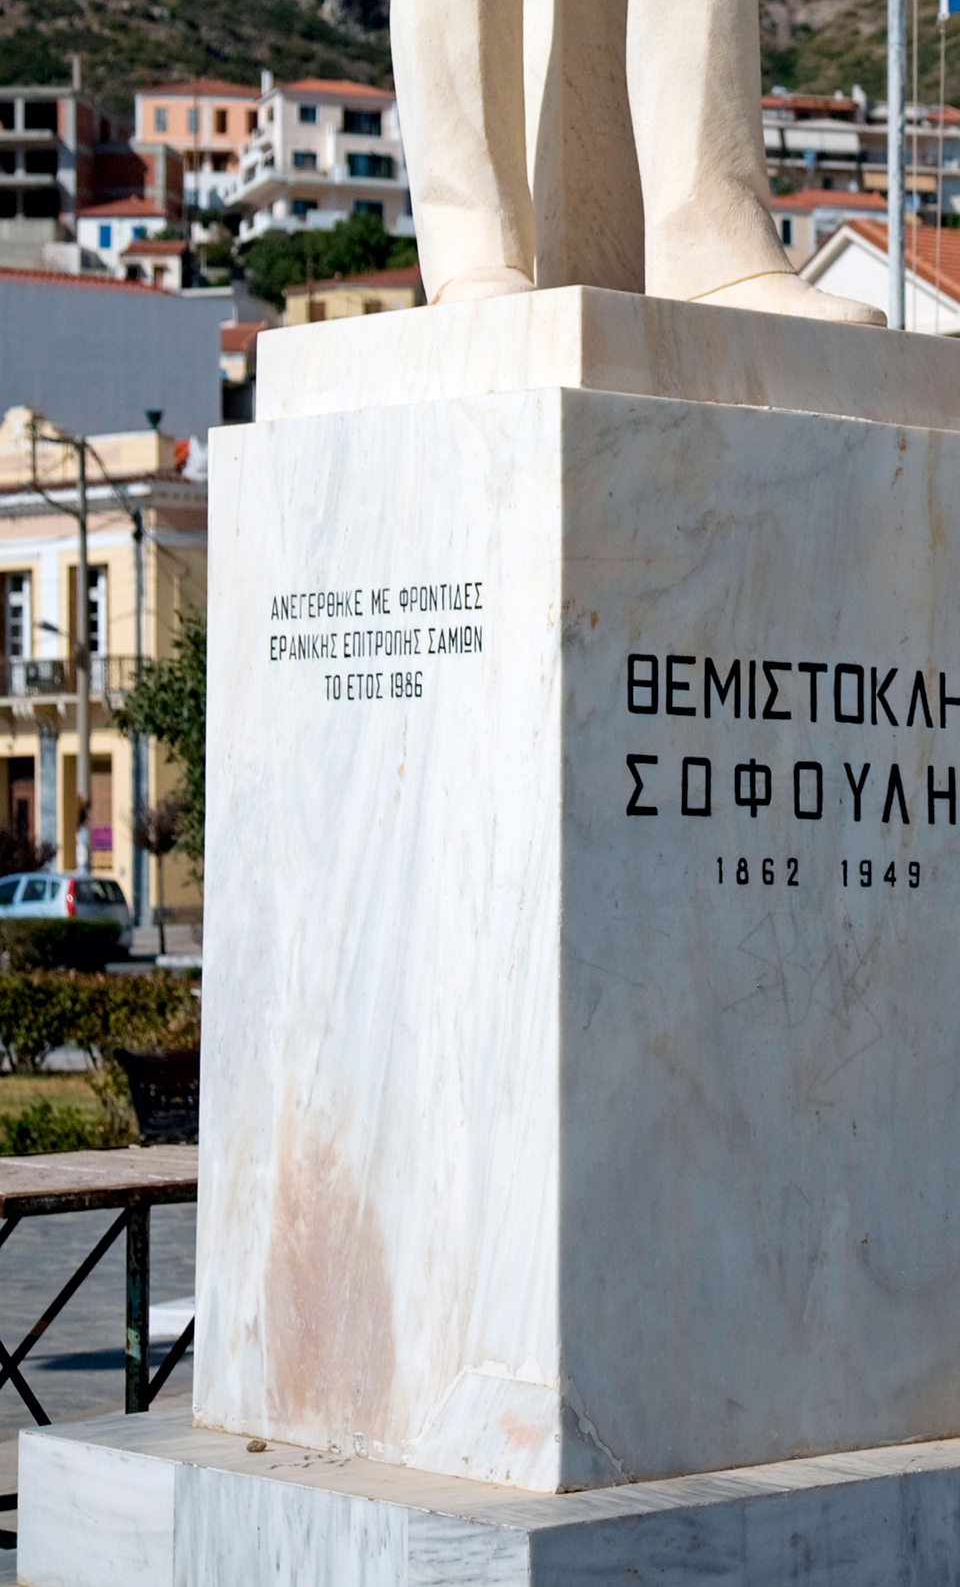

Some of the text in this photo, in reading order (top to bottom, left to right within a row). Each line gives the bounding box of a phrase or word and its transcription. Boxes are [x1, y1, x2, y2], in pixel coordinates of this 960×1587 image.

[271, 582, 483, 620] ΑΝΕΓΕΡΘΗΚΕ ΜΕ ΦΡΟΝΤΙΔΕΣ
[270, 626, 483, 661] ΕΡΑΝΙΚΗΣ ΕΠΙΤΡΟΠΗΣ ΣΑΜΙΩΝ
[325, 671, 423, 701] ΤΟ ΕΤΟΣ 1986
[716, 857, 921, 889] 1862 1949
